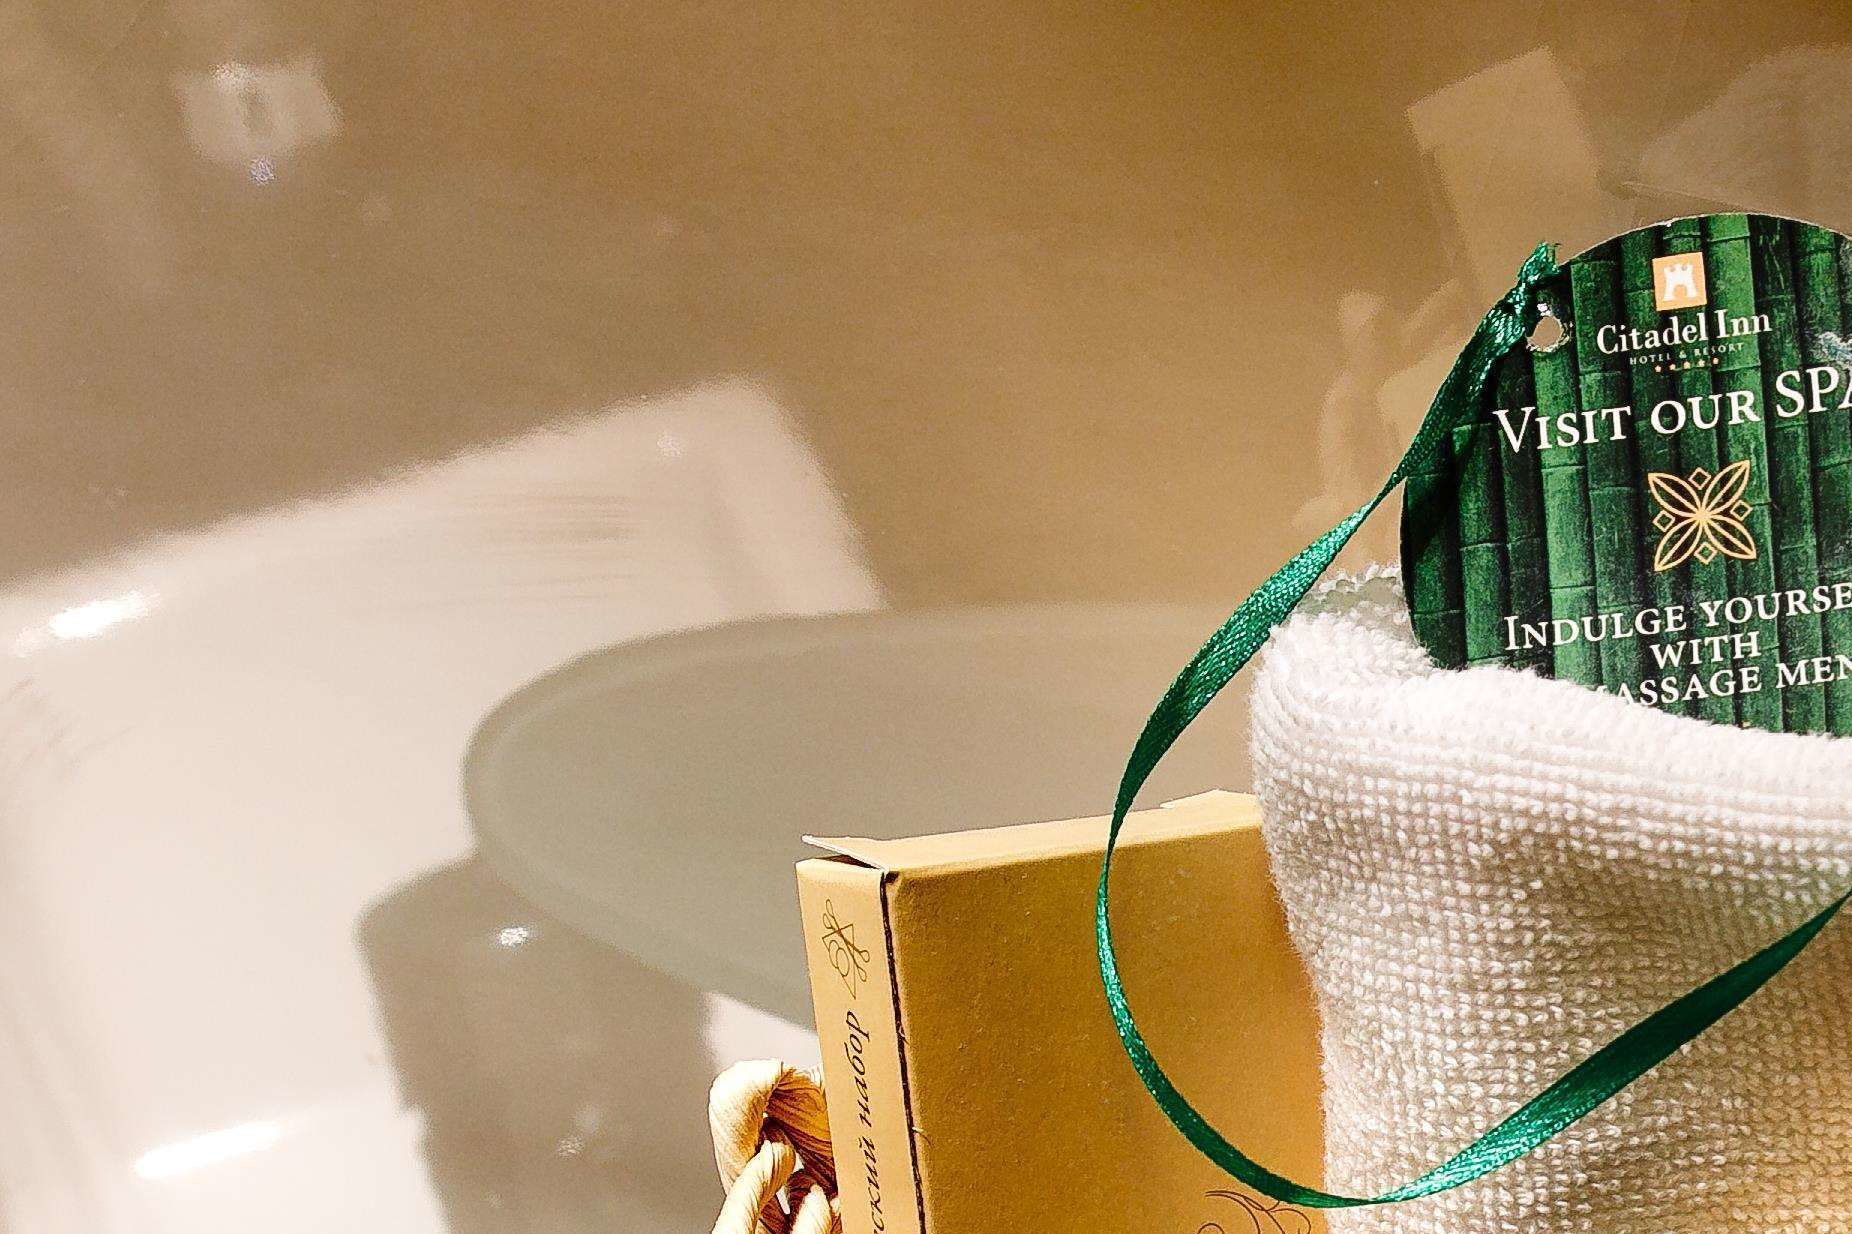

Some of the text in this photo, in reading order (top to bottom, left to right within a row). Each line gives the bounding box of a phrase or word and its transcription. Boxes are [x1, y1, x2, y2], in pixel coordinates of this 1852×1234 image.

[1597, 309, 1772, 354] Citadel Inn
[1629, 342, 1744, 365] HOTEL & RESORT
[1492, 406, 1631, 453] VISIT
[1650, 390, 1761, 434] OUR
[1504, 605, 1687, 650] INDULGE
[1649, 631, 1761, 669] WITH
[1613, 666, 1761, 707] ASSAGE
[843, 1009, 872, 1132] набор
